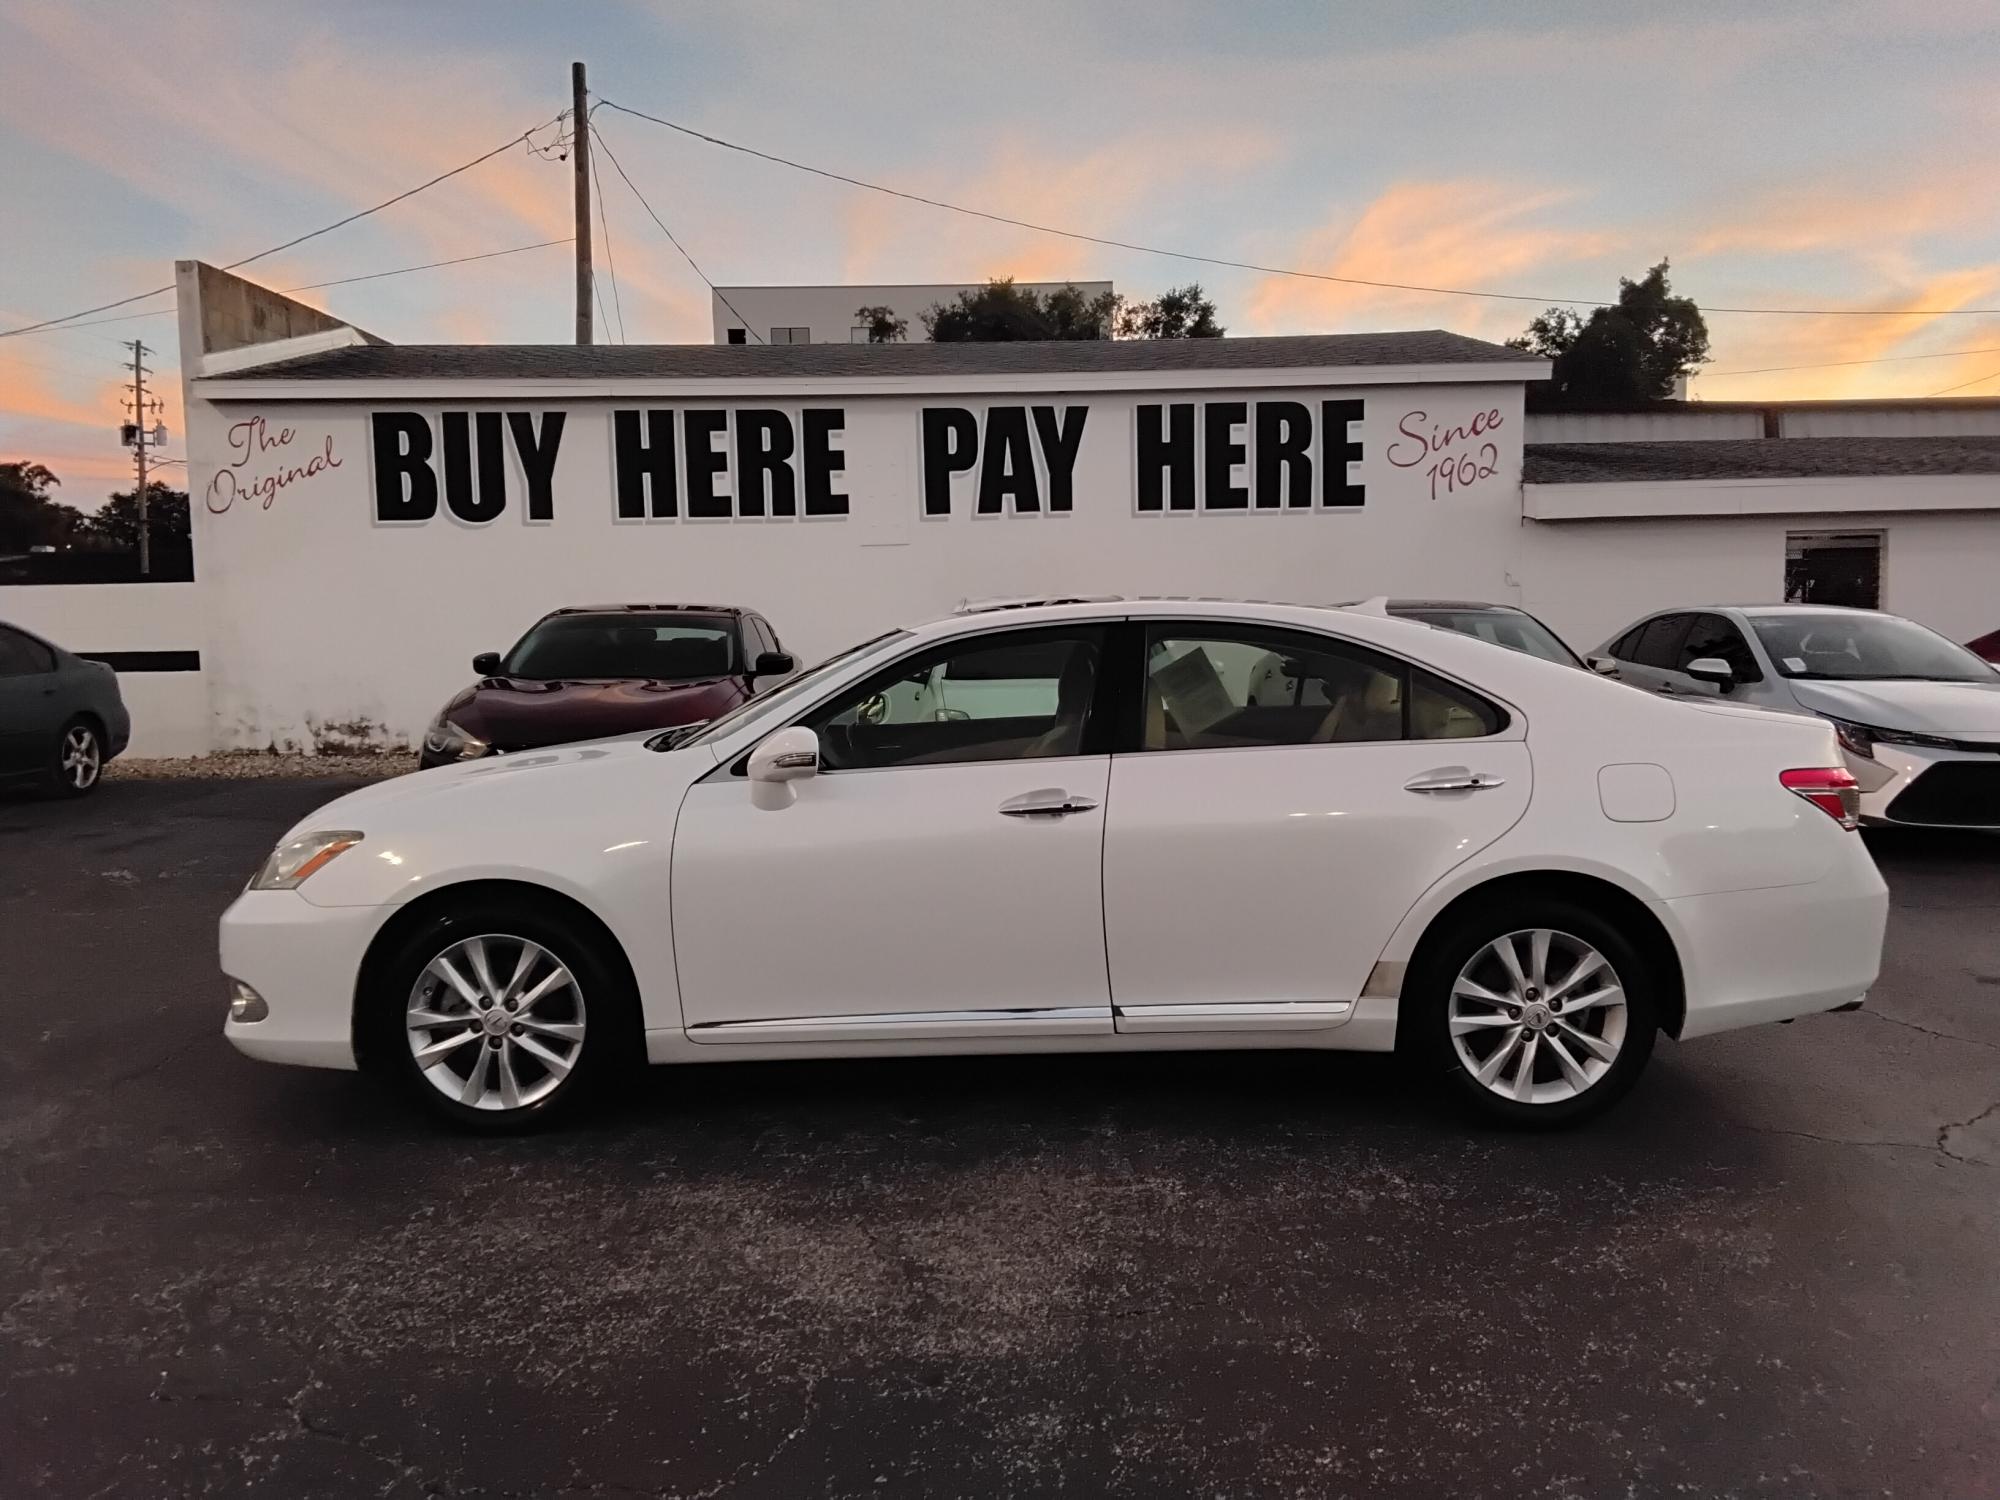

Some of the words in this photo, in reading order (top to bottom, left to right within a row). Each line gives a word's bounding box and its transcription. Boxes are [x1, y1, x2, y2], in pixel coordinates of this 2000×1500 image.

[228, 415, 296, 468] The
[372, 412, 566, 522] BUY
[614, 409, 849, 518] HERE
[923, 406, 1089, 514] PAY
[1137, 399, 1365, 511] HERE
[1387, 408, 1504, 468] Since
[206, 434, 343, 514] Original
[1426, 443, 1499, 501] 1962
